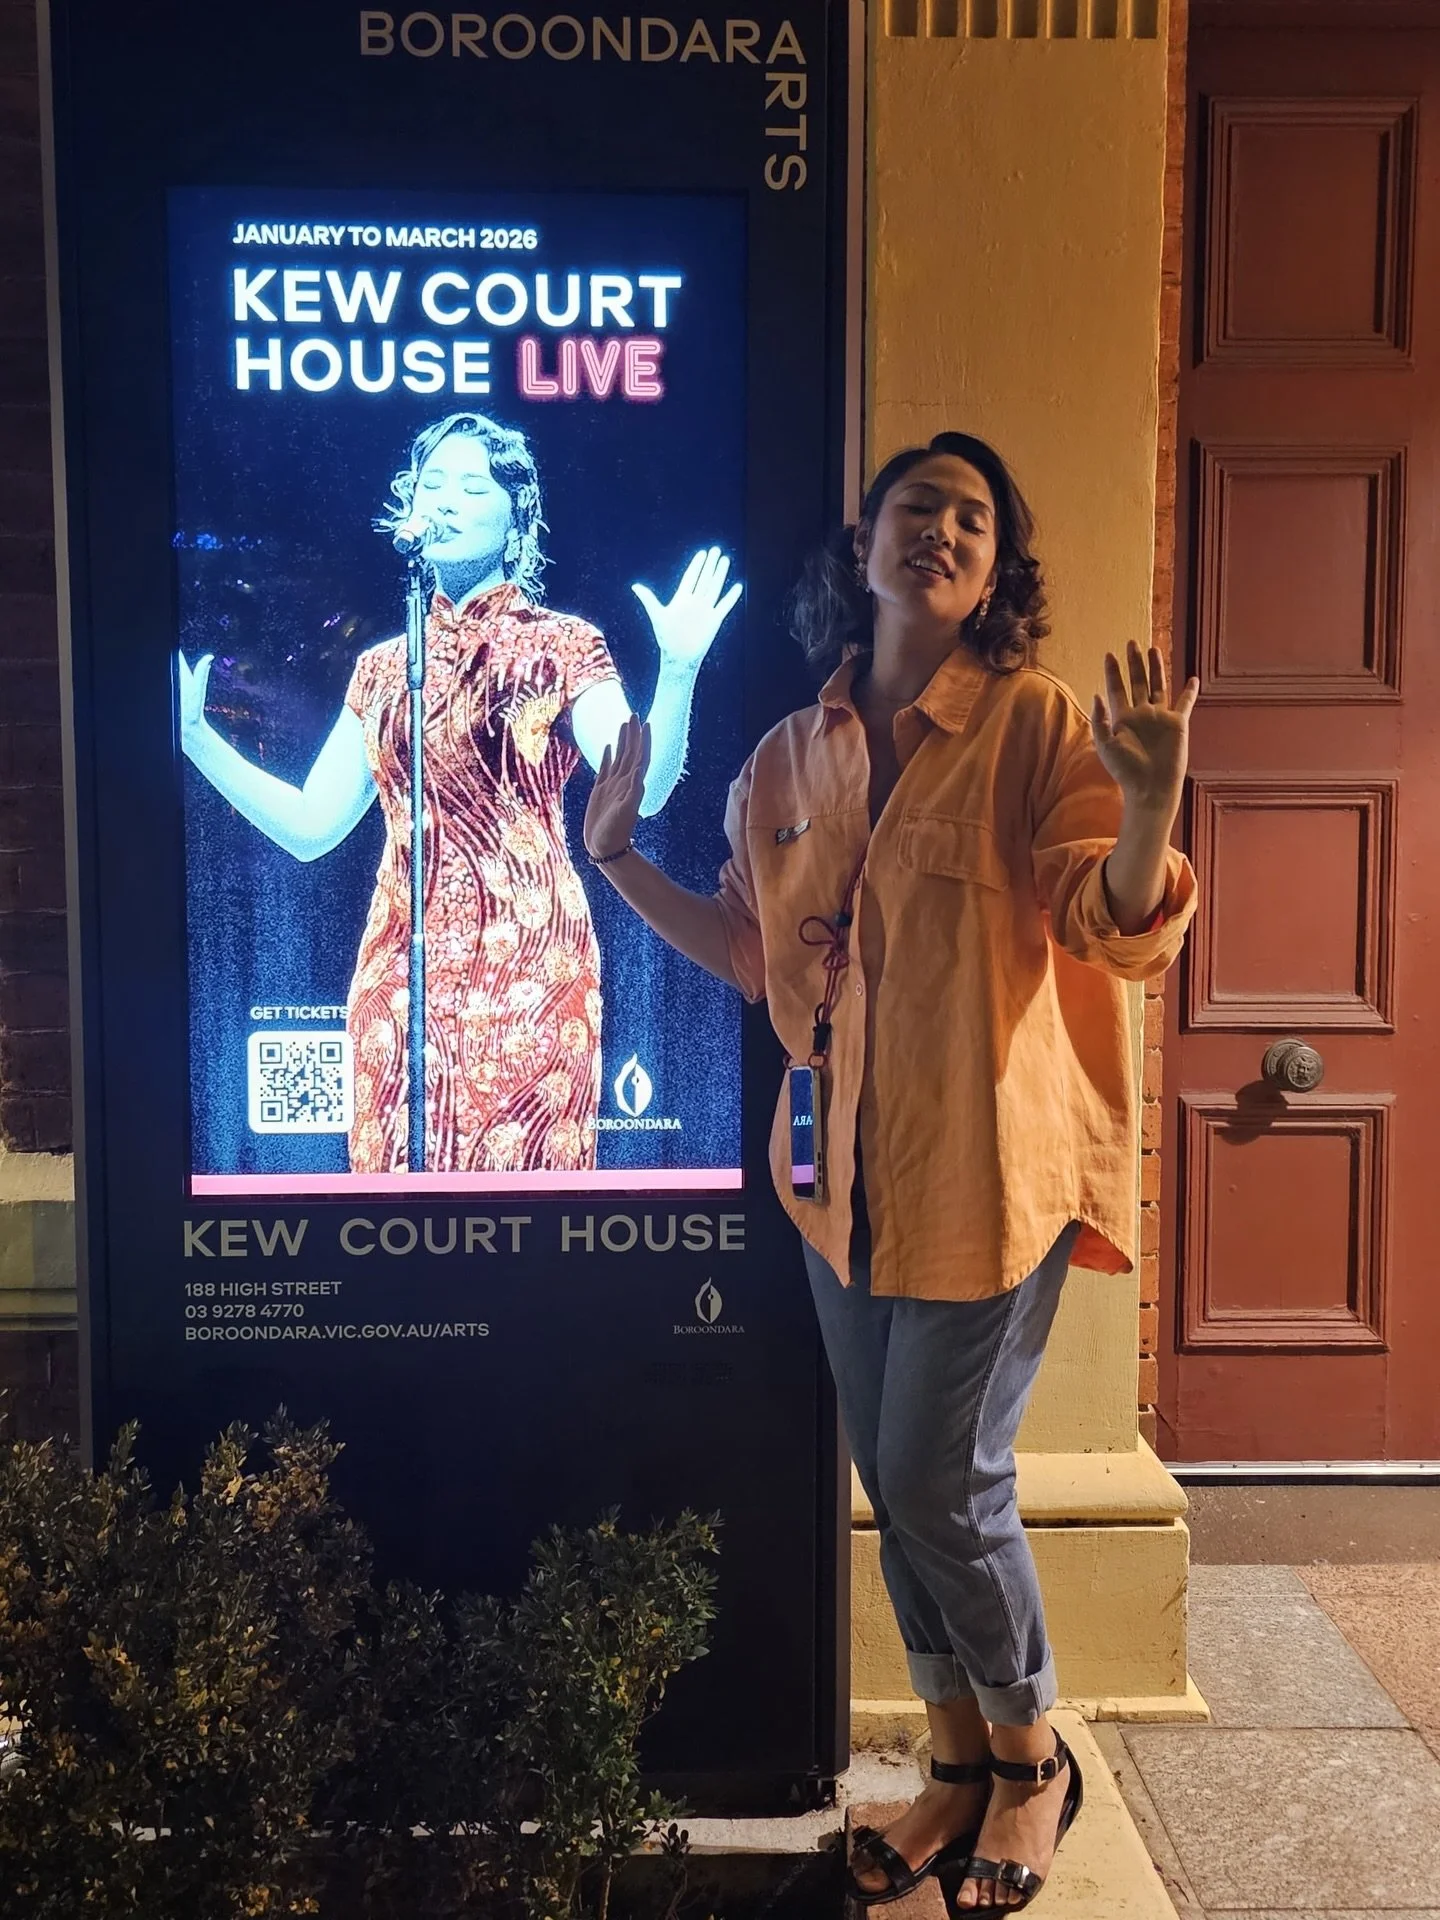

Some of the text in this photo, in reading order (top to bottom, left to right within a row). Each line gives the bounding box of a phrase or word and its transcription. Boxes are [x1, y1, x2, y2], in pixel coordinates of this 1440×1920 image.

[360, 10, 807, 64] BOROONDARA
[232, 224, 537, 249] JANUARY TO MARCH 2026
[233, 269, 682, 328] KEW COURT
[235, 337, 664, 400] HOUSE LIVE
[250, 1006, 282, 1020] GET
[588, 1118, 682, 1130] BOROONDARA
[183, 1214, 746, 1258] KEW COURT HOUSE
[184, 1281, 342, 1296] 188 HIGH STREET
[185, 1304, 304, 1318] 03 9278 4770
[185, 1323, 490, 1341] BOROONDARA.VIC.GOV.AU/ARTS
[673, 1325, 745, 1335] BOROONDARA
